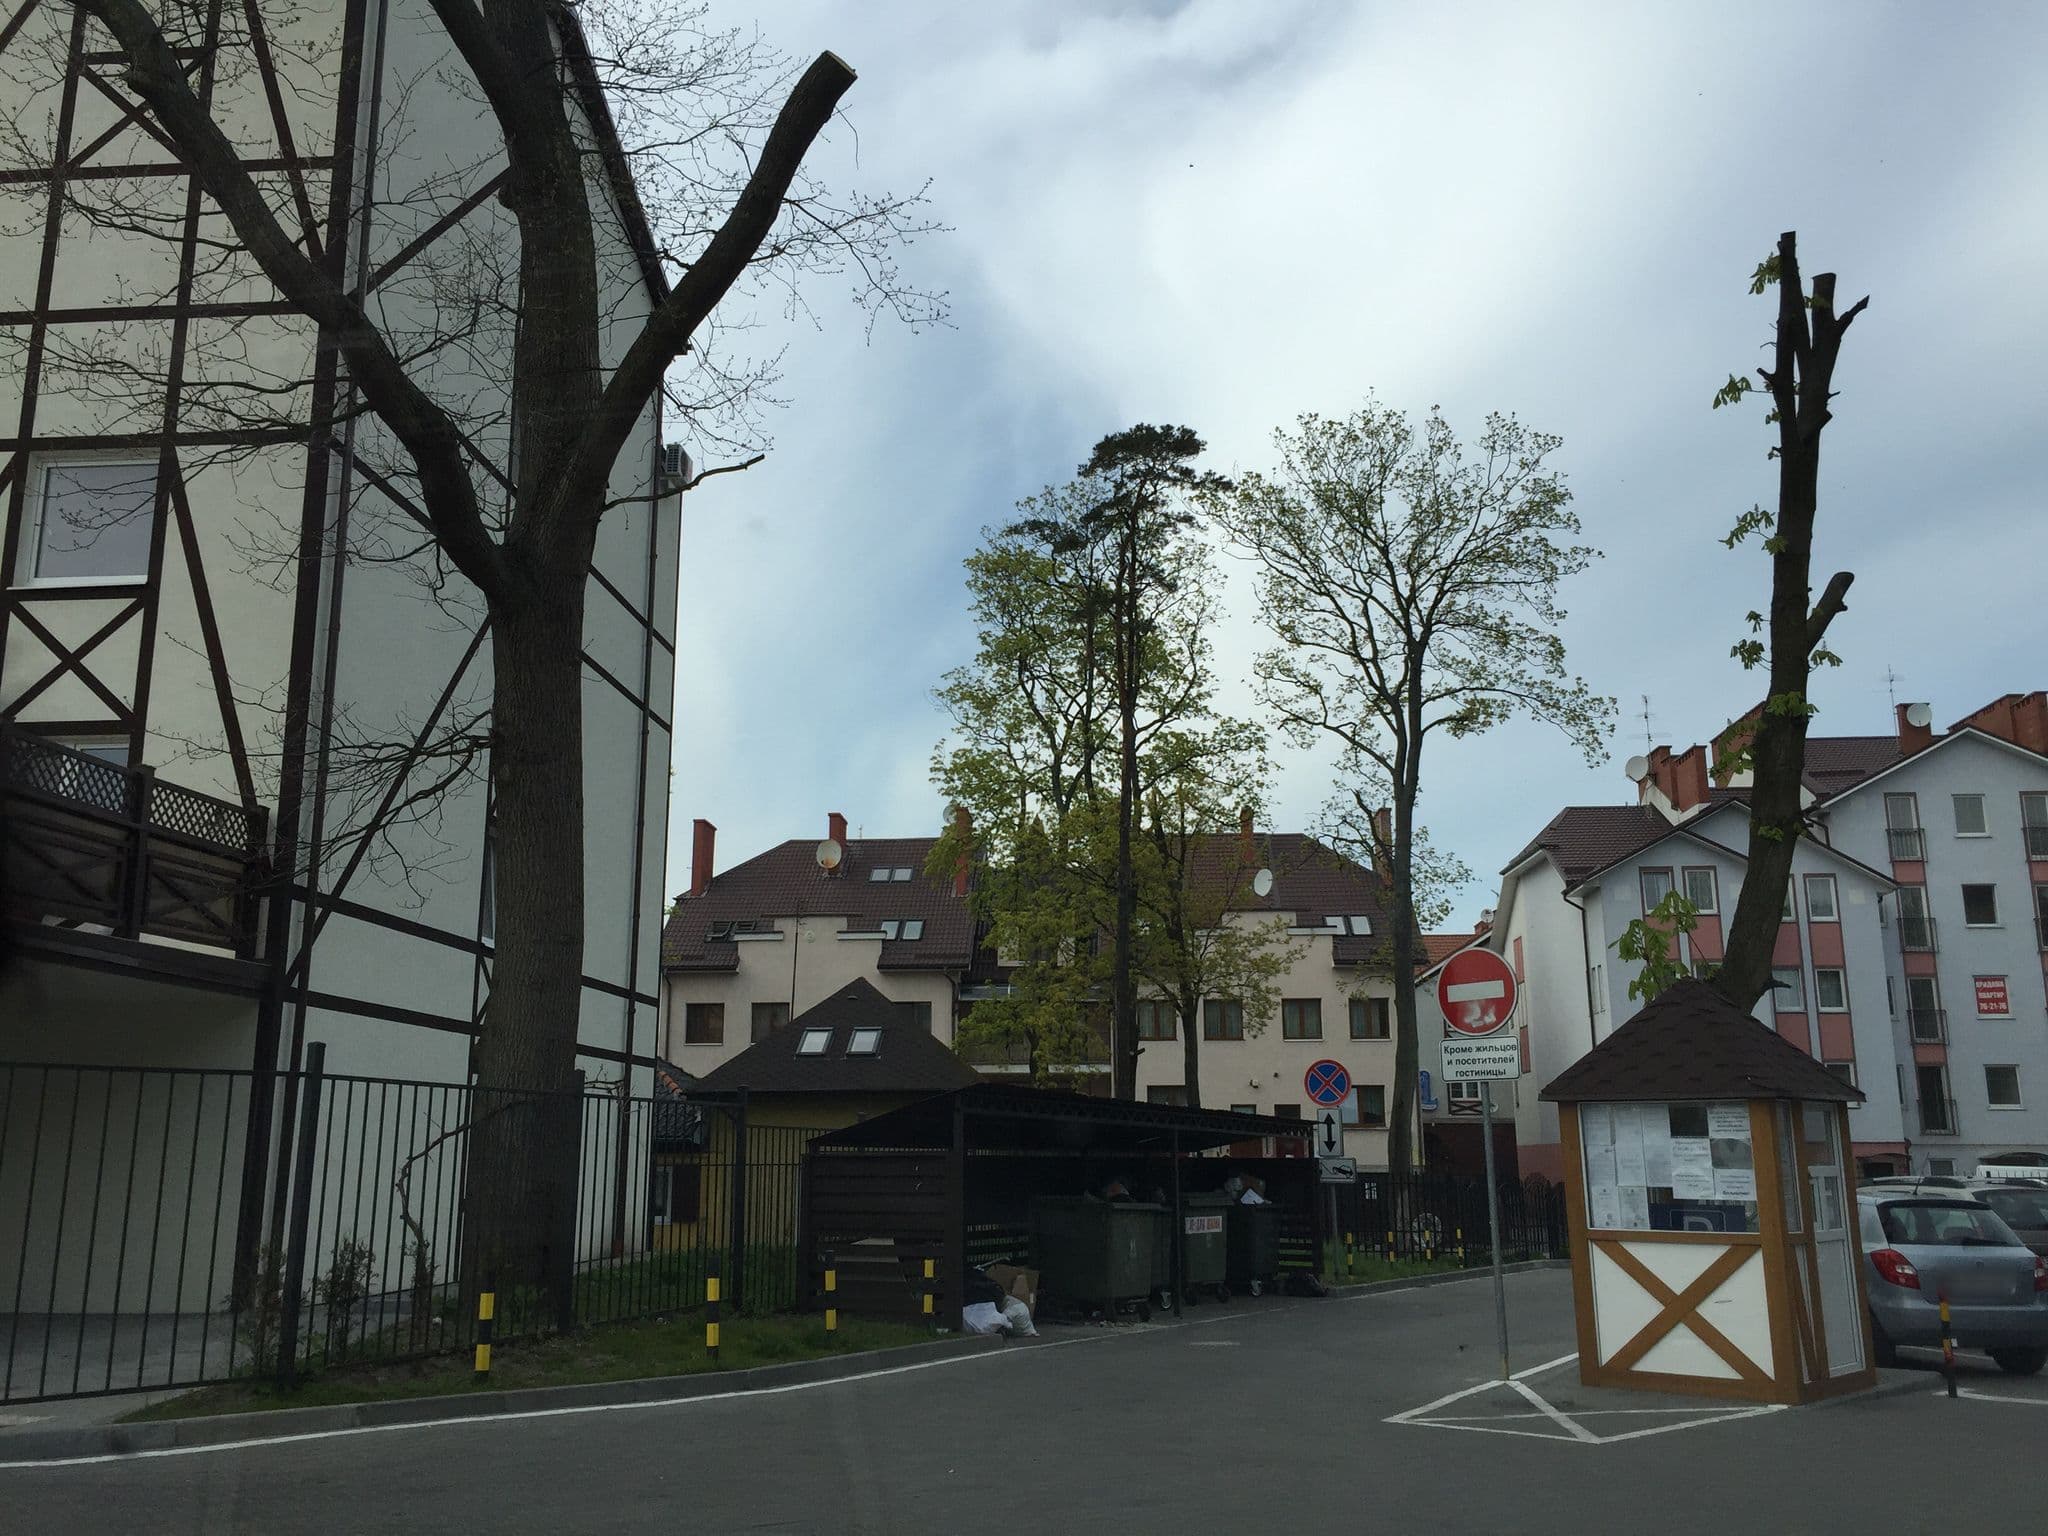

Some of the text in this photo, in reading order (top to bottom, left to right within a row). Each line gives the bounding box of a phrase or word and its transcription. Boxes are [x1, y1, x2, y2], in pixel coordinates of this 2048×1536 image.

[1444, 1044, 1517, 1056] Кроме жильцов
[1455, 1055, 1515, 1066] посетителей
[1455, 1068, 1506, 1078] гостиницы
